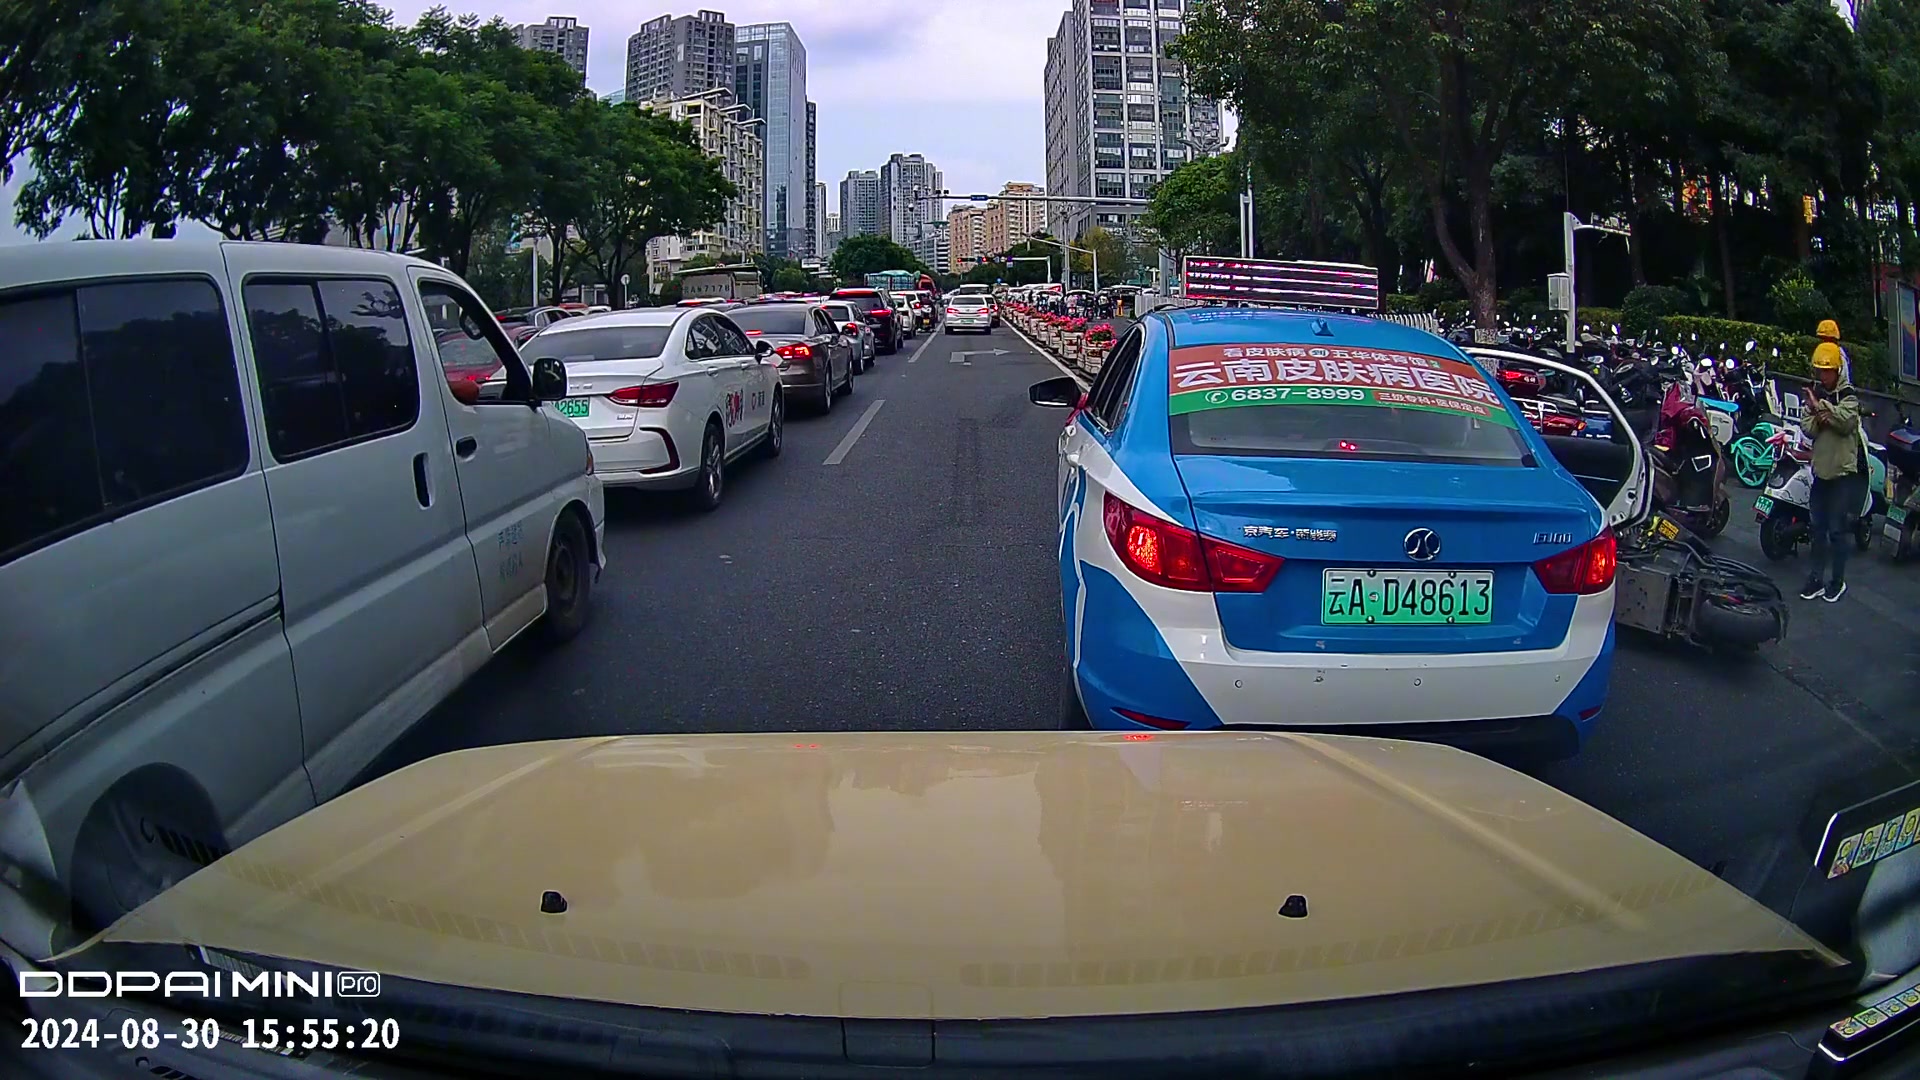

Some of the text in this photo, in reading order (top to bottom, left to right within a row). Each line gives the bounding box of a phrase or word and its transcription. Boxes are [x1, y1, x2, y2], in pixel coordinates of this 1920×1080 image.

[1173, 359, 1502, 406] 云南皮肤病医院
[1231, 388, 1365, 403] 6837-8999
